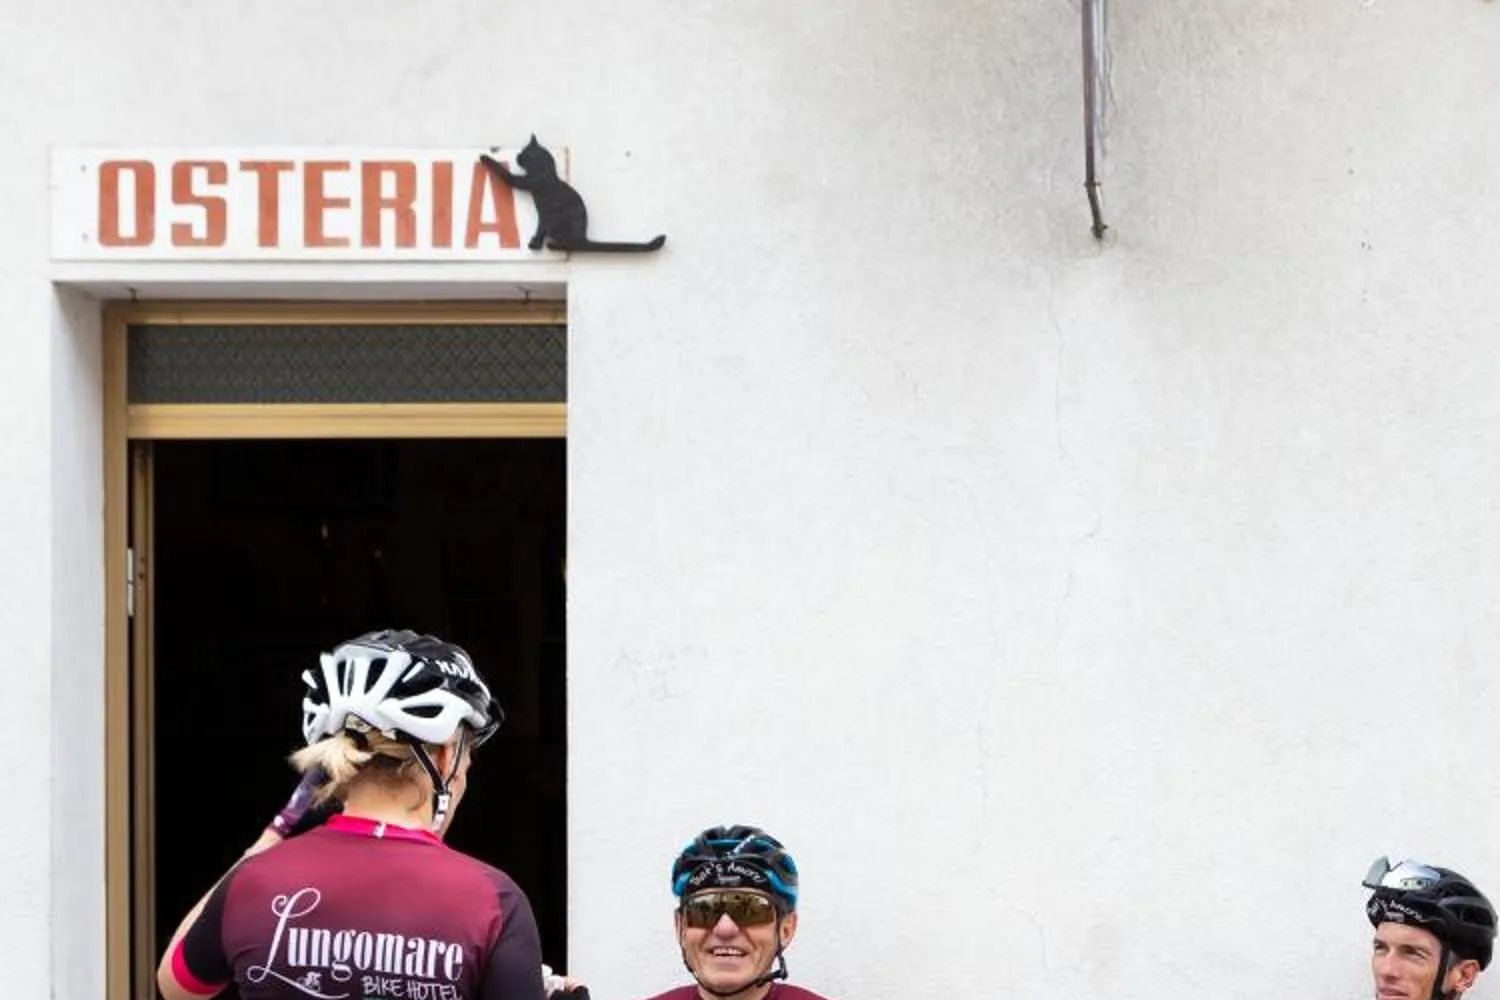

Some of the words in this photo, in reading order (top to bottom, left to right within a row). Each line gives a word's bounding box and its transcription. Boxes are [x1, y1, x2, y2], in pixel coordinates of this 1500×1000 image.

[98, 160, 520, 248] OSTERIA
[247, 887, 463, 999] Lungomare
[361, 975, 404, 998] BIKE
